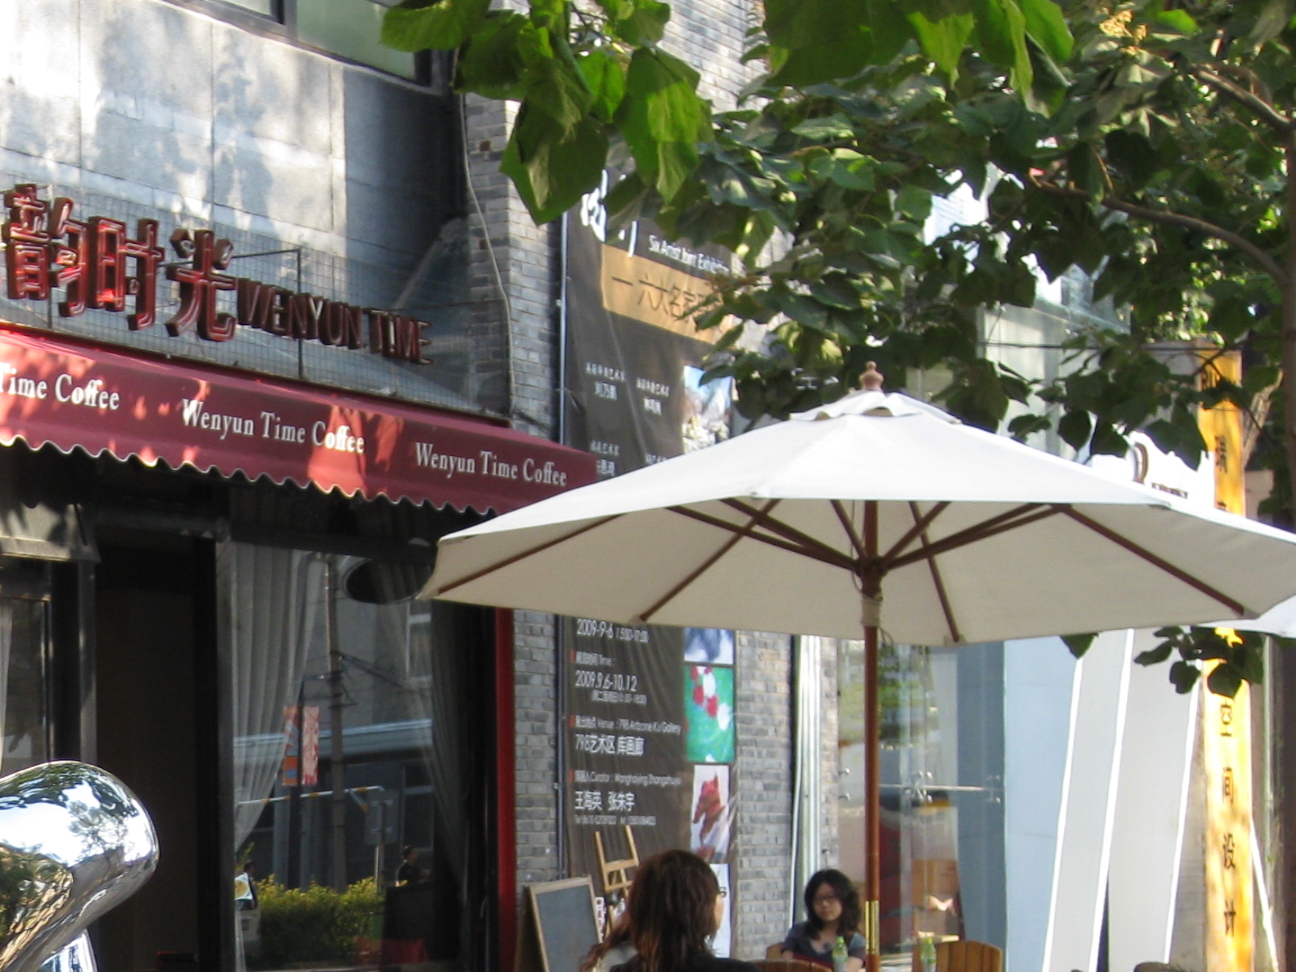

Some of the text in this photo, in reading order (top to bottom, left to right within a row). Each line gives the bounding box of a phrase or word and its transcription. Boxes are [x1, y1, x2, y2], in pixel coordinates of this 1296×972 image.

[237, 277, 363, 350] WENYUN
[54, 375, 121, 412] Coffee
[181, 397, 365, 455] Wenyun Time Coffee
[414, 442, 476, 479] Wenyun
[480, 452, 518, 480] Time
[523, 459, 568, 487] Coffee
